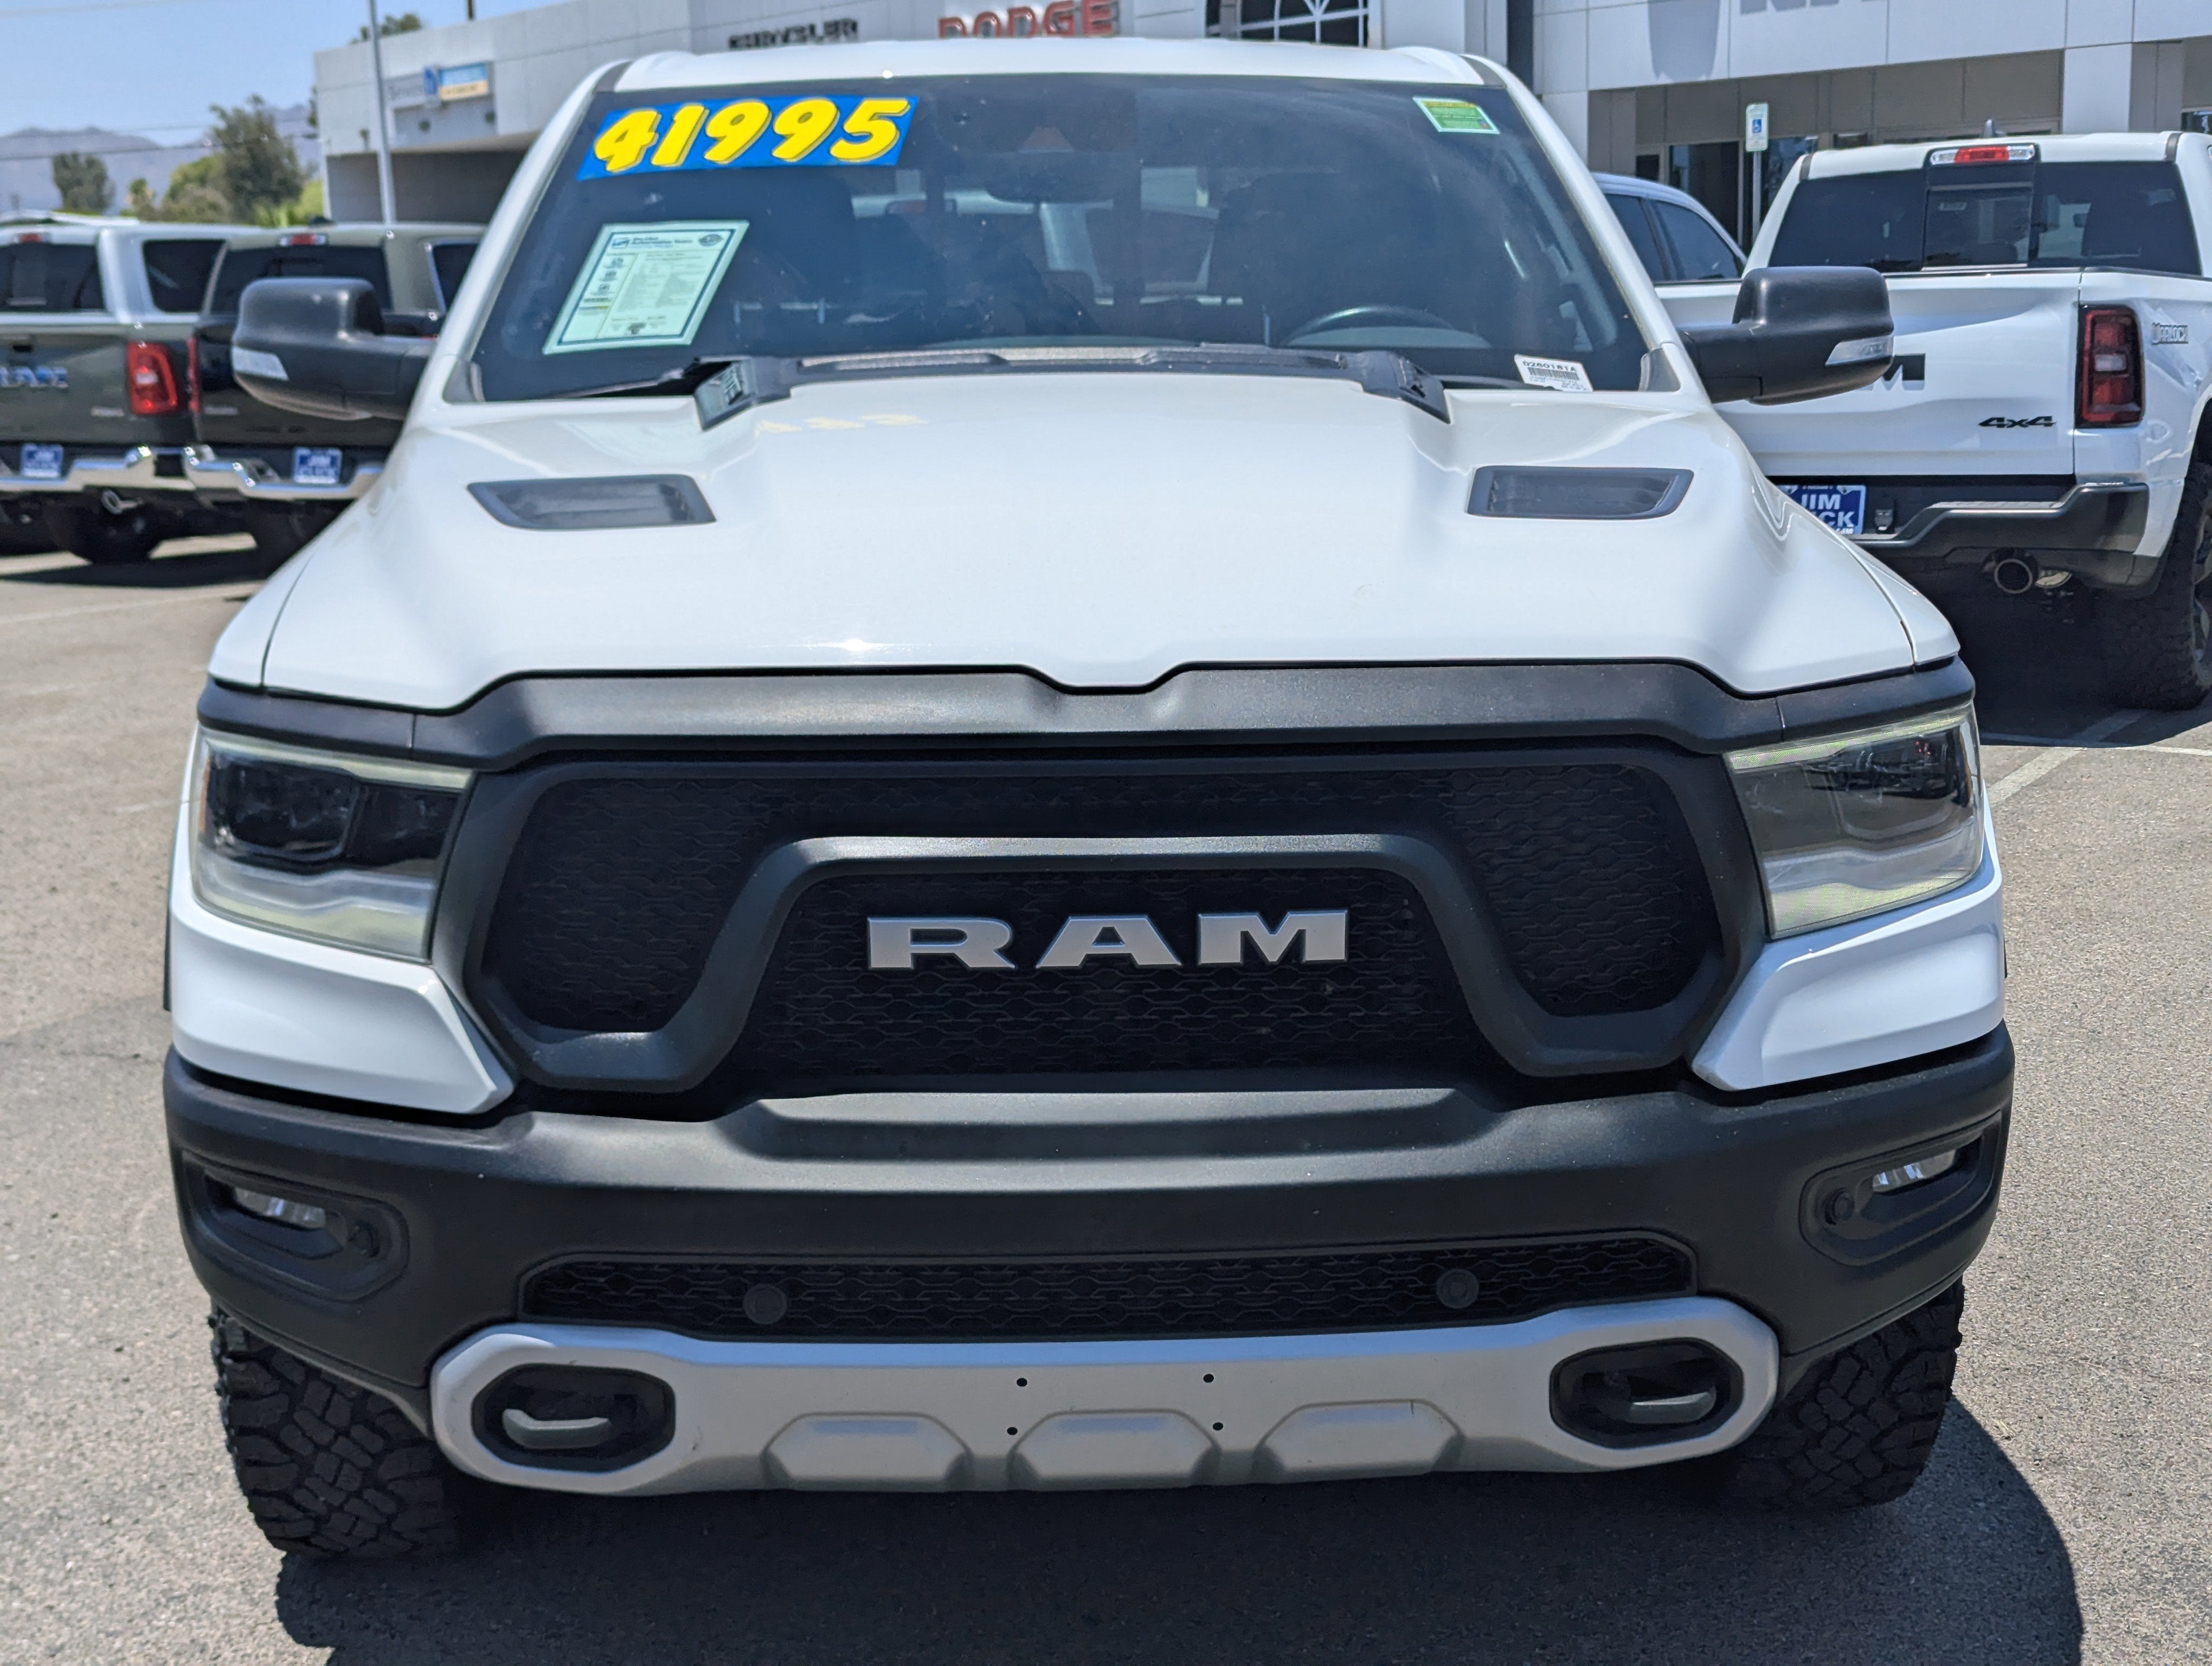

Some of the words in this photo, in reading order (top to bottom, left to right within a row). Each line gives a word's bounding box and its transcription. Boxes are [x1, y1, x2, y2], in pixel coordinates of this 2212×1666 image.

[938, 0, 1120, 38] DODGE
[594, 98, 910, 172] 41995
[1978, 415, 2056, 428] 4x4
[1801, 494, 1841, 510] JIM
[867, 910, 1347, 969] RAM
